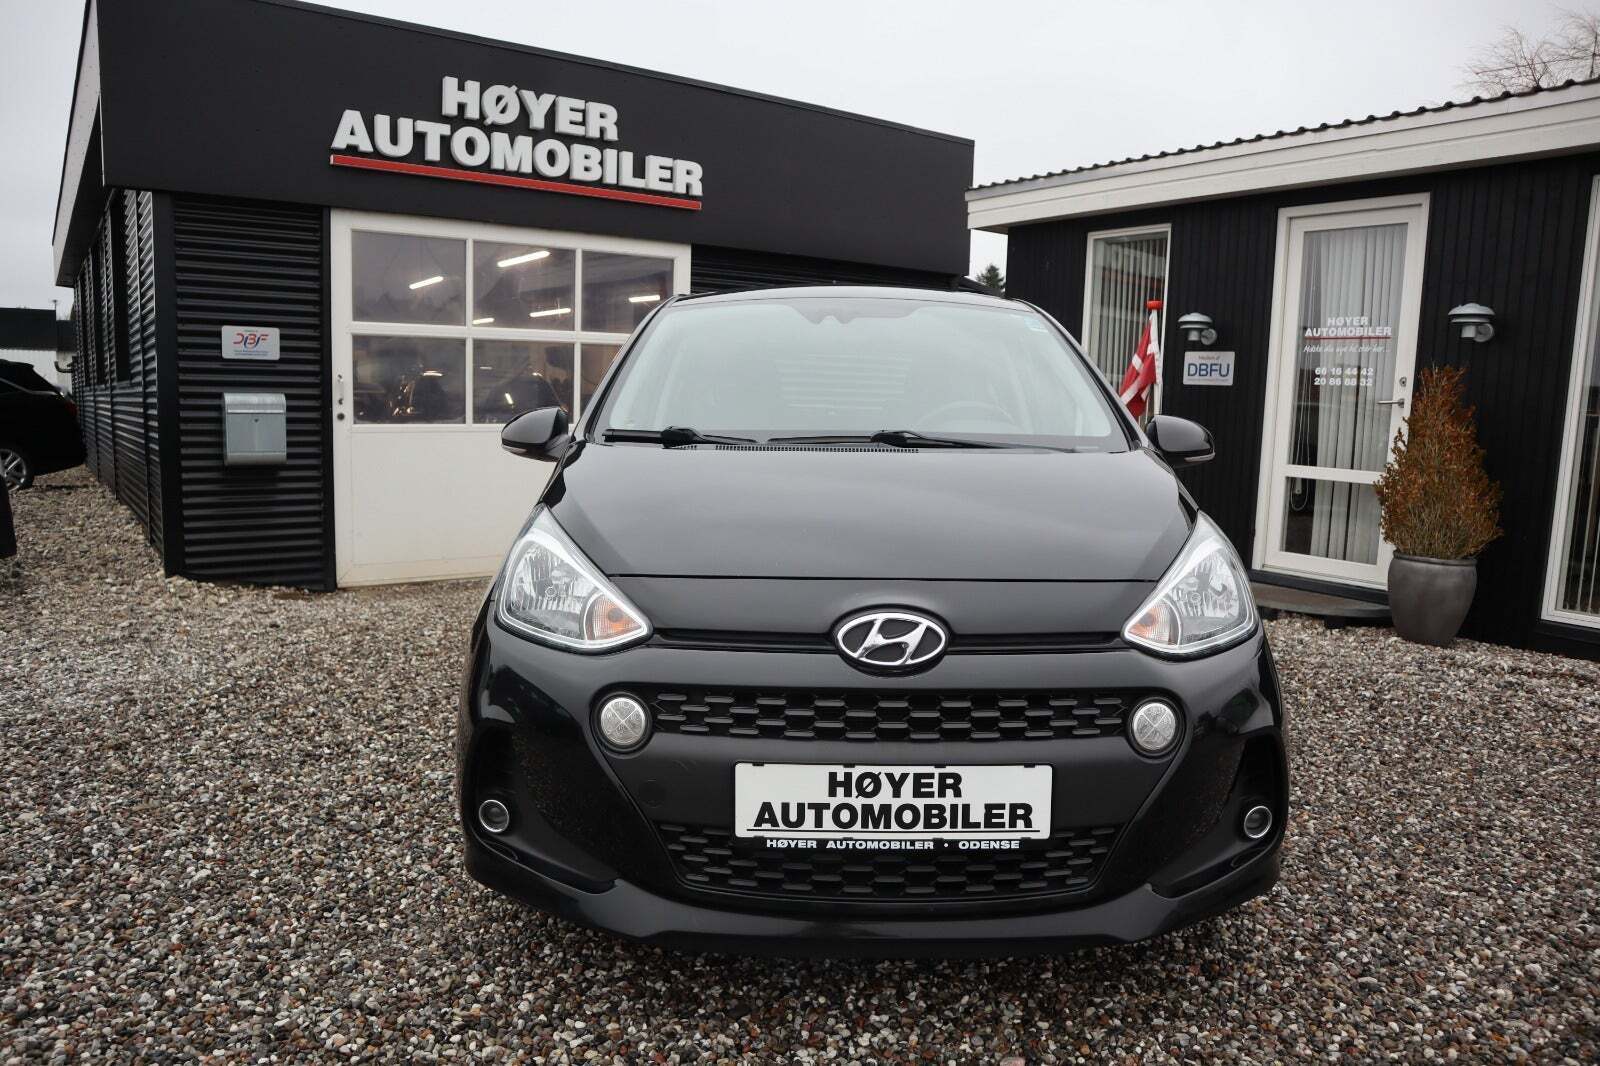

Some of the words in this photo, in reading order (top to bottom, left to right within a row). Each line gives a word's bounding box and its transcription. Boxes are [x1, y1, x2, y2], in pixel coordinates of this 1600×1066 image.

[441, 76, 619, 142] HØYER
[330, 108, 703, 197] AUTOMOBILER
[1304, 326, 1392, 336] AUTOMOBILER
[1188, 362, 1230, 377] DBFU
[1313, 378, 1327, 386] 20
[827, 771, 963, 799] HØYER
[753, 801, 1034, 830] AUTOMOBILER
[766, 838, 817, 849] HØYER
[826, 839, 934, 850] AUTOMOBILER
[958, 840, 1020, 850] ODENSE
